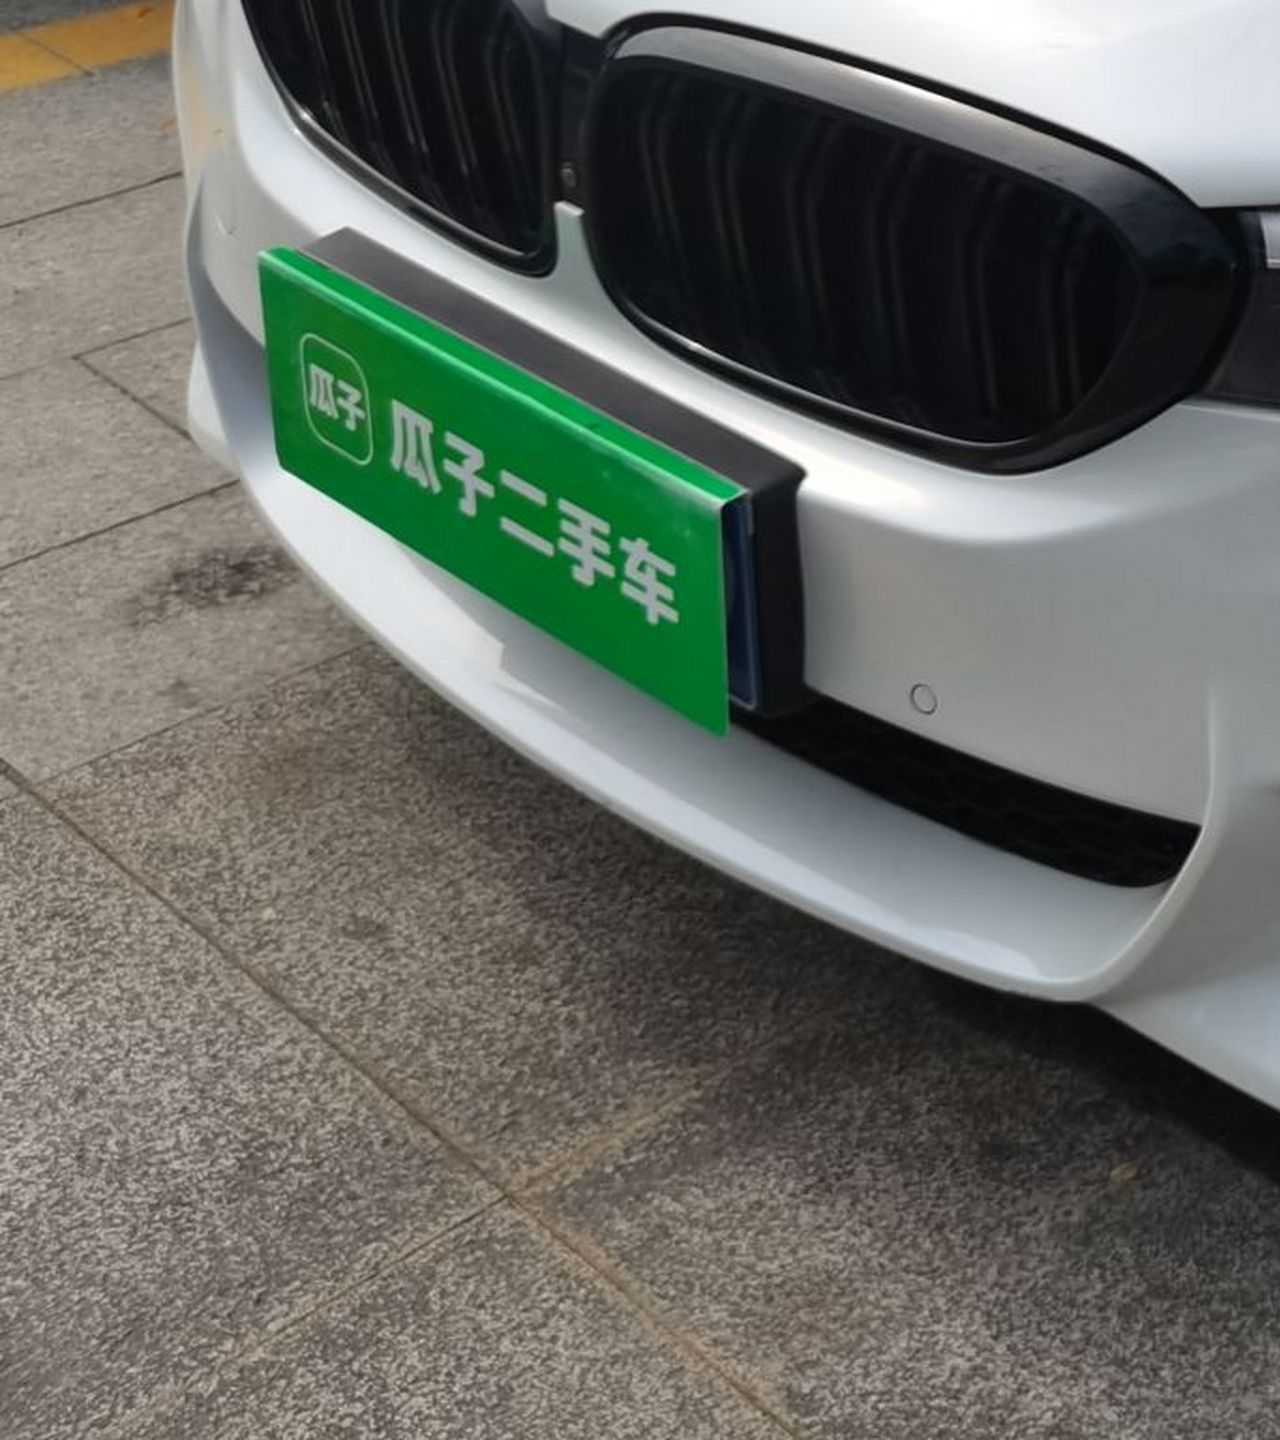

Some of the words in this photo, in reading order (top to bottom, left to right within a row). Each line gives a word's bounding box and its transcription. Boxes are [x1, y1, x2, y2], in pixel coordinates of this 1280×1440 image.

[309, 363, 366, 432] 瓜子
[390, 398, 680, 625] 瓜子二手车
